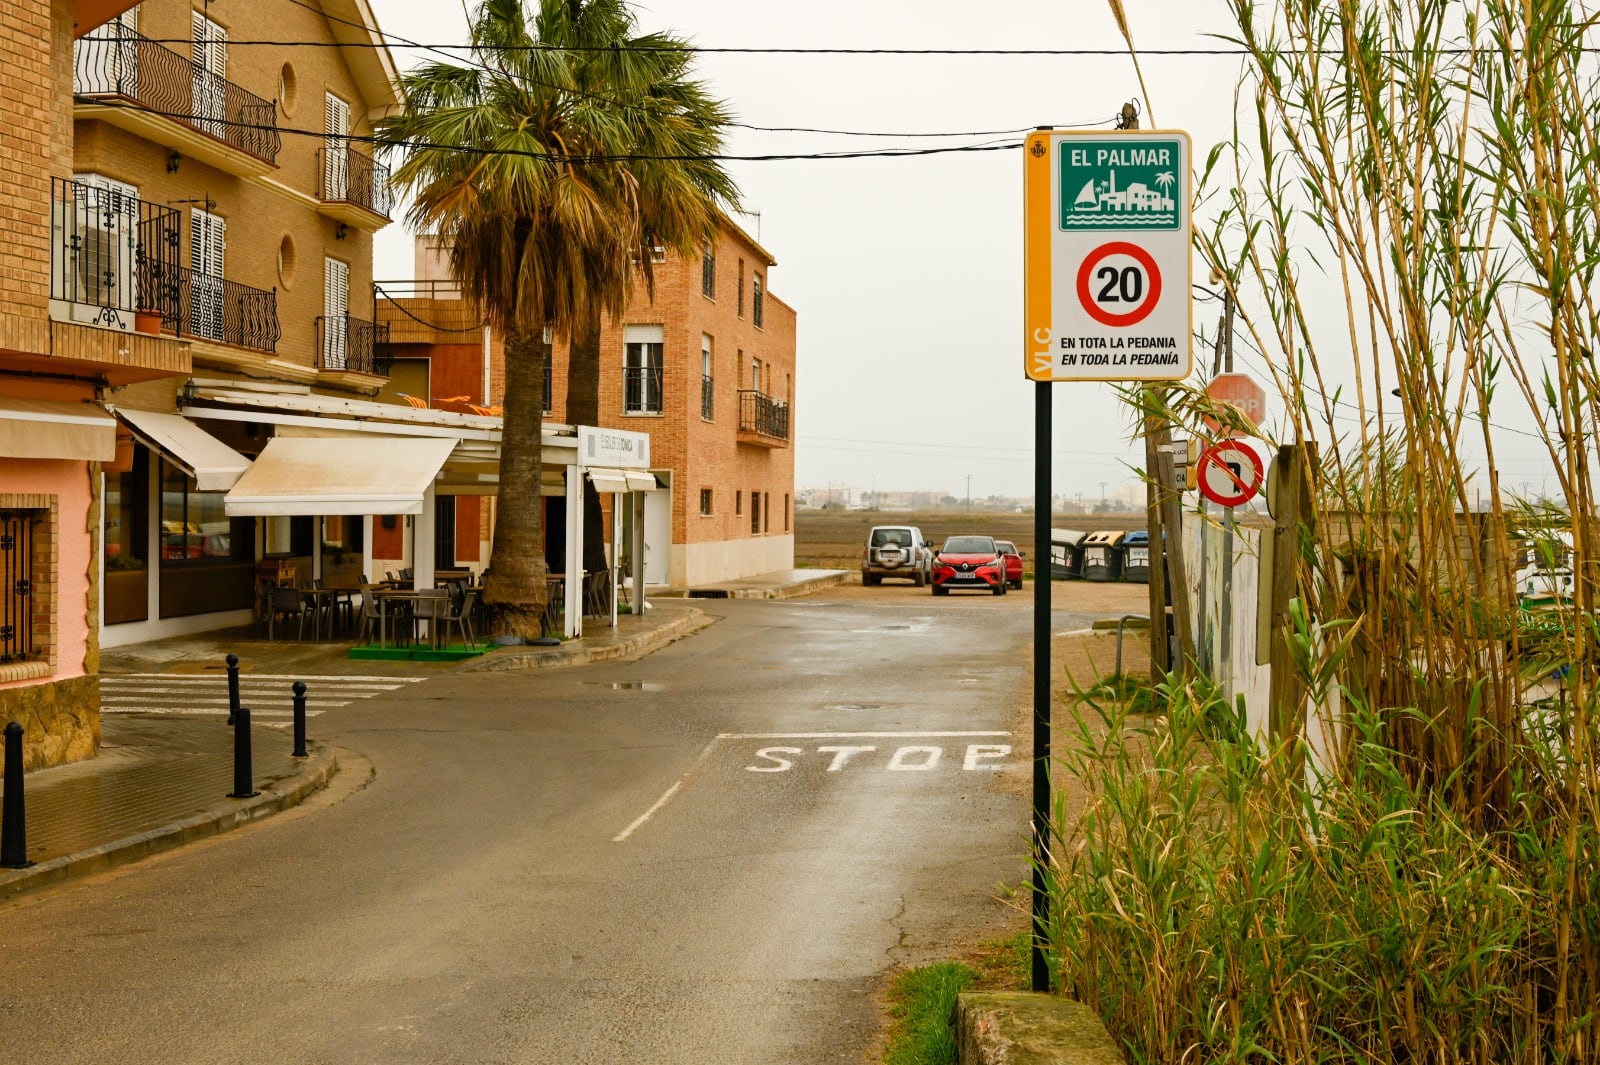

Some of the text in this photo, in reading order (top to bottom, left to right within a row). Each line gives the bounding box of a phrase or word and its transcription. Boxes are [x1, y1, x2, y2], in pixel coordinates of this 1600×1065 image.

[1071, 148, 1170, 166] EL PALMAR
[1097, 266, 1142, 302] 20
[1034, 328, 1052, 374] VLC
[1061, 337, 1176, 349] EN TOTA LA PEDANIA
[1061, 352, 1179, 365] EN TODA LA PEDANÍA
[744, 744, 1013, 773] STOP
